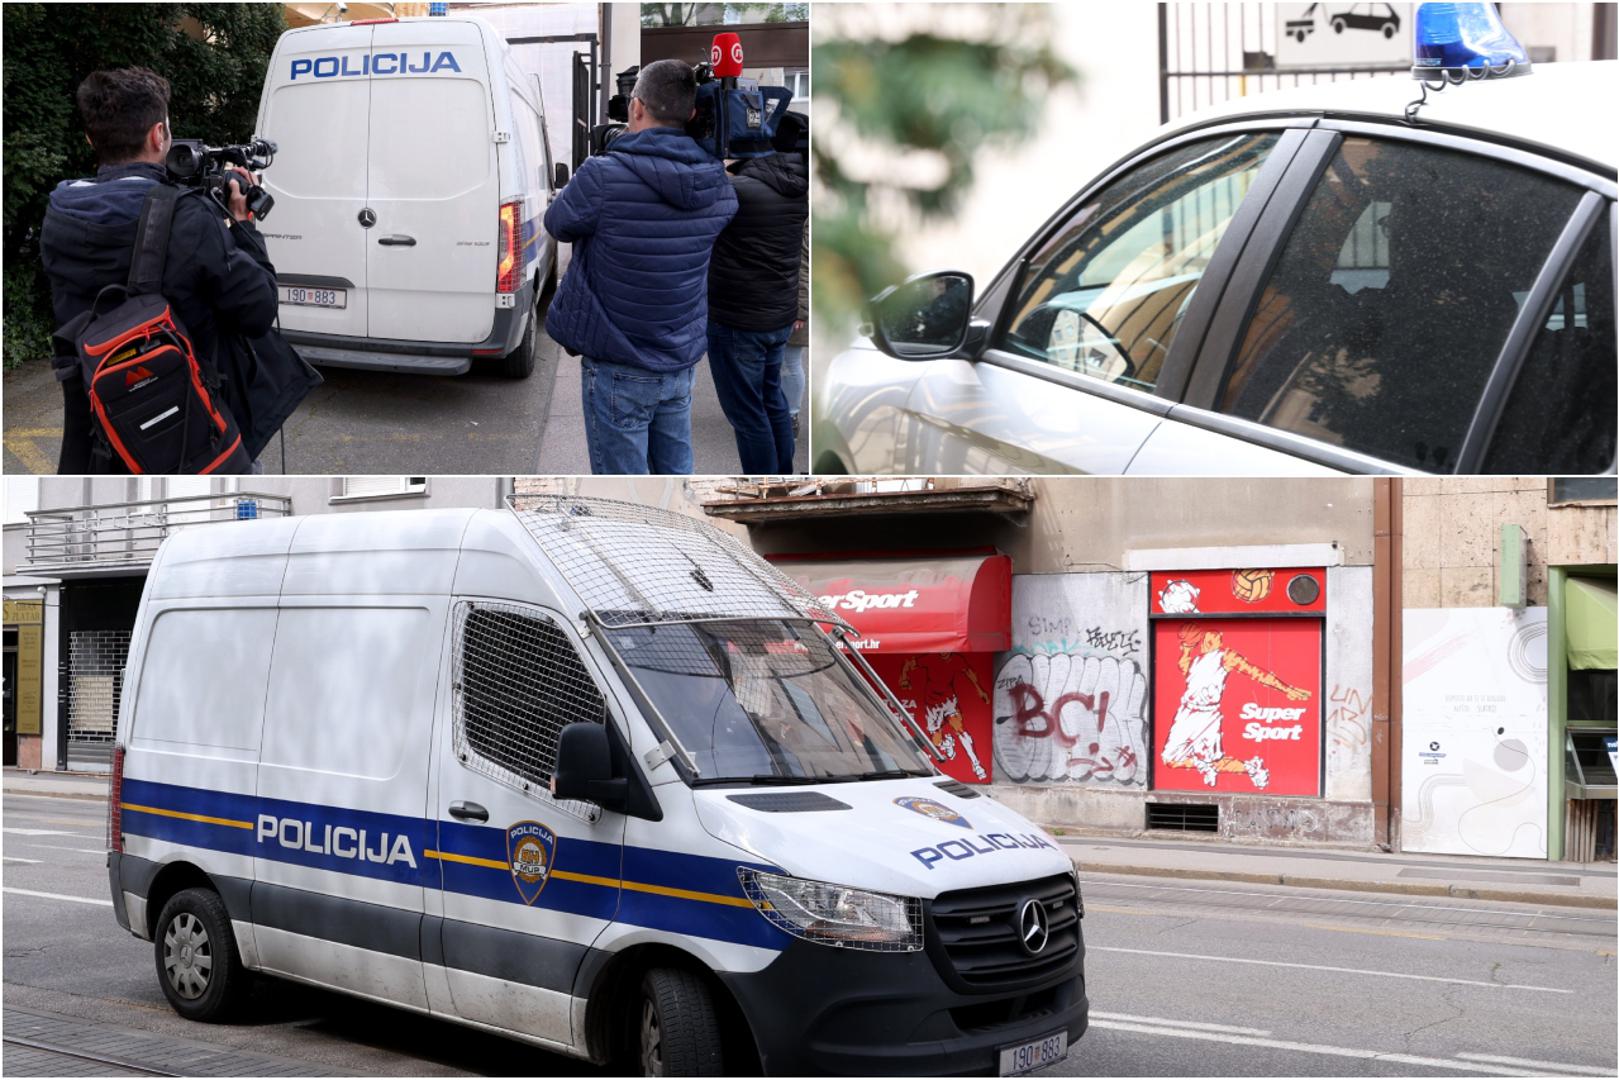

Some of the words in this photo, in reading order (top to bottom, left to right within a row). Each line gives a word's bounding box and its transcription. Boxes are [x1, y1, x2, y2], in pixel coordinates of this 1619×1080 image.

[290, 51, 462, 80] POLICIJA
[287, 288, 306, 302] 190
[314, 290, 336, 305] 883
[800, 590, 921, 612] erSport
[1239, 702, 1307, 724] Super
[1241, 722, 1304, 743] Sport
[257, 813, 418, 869] POLICIJA
[510, 825, 553, 845] POLICIJA
[910, 833, 1059, 870] POLICIJA
[1013, 1045, 1033, 1070] 190
[1041, 1036, 1060, 1061] 883
